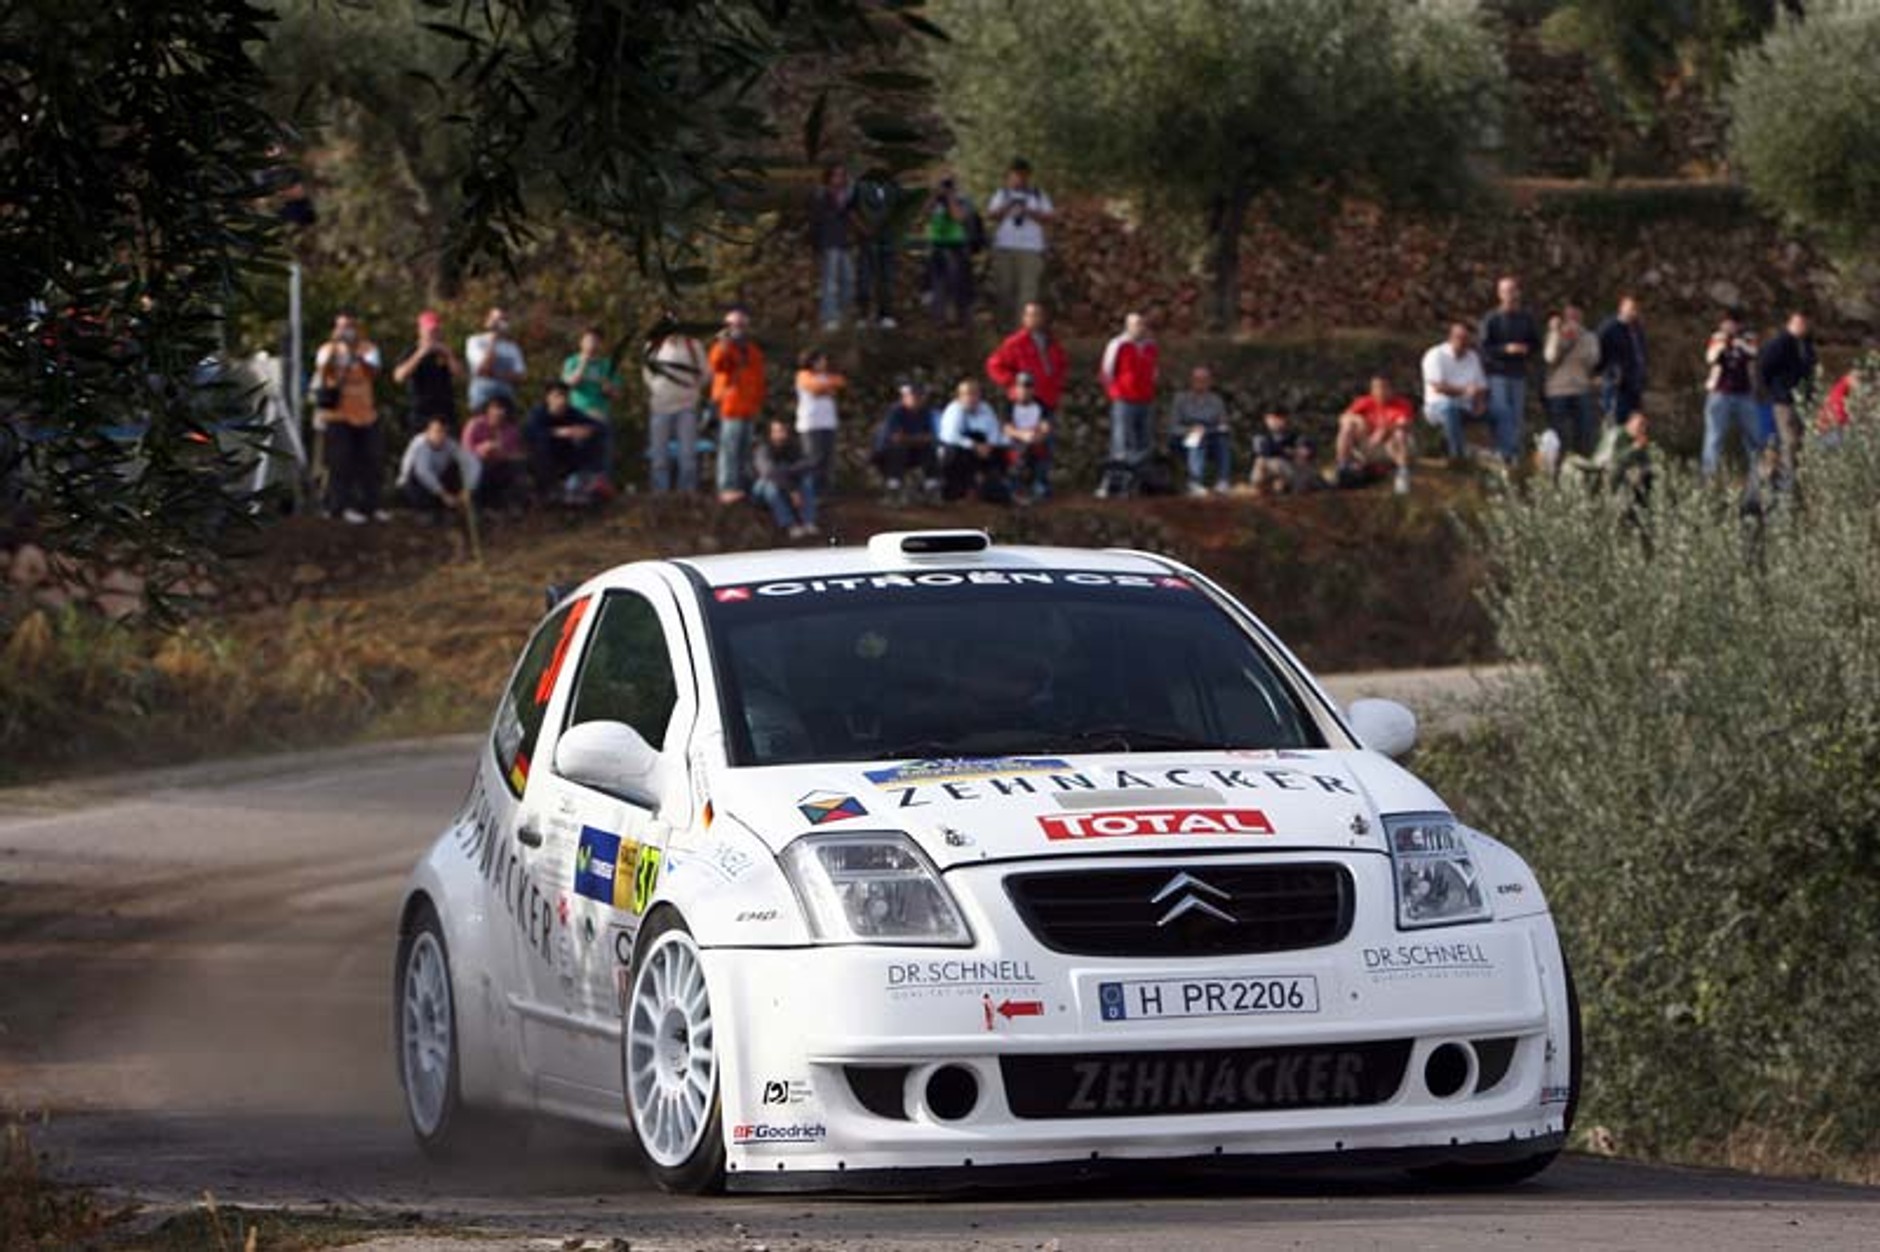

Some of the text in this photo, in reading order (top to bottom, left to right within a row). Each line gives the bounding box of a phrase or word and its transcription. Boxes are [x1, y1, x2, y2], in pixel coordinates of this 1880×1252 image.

[1045, 813, 1266, 836] TOTAL
[1363, 943, 1488, 967] DR.SCHNELL
[888, 960, 1036, 984] DR.SCHNELL
[1139, 984, 1163, 1015] H
